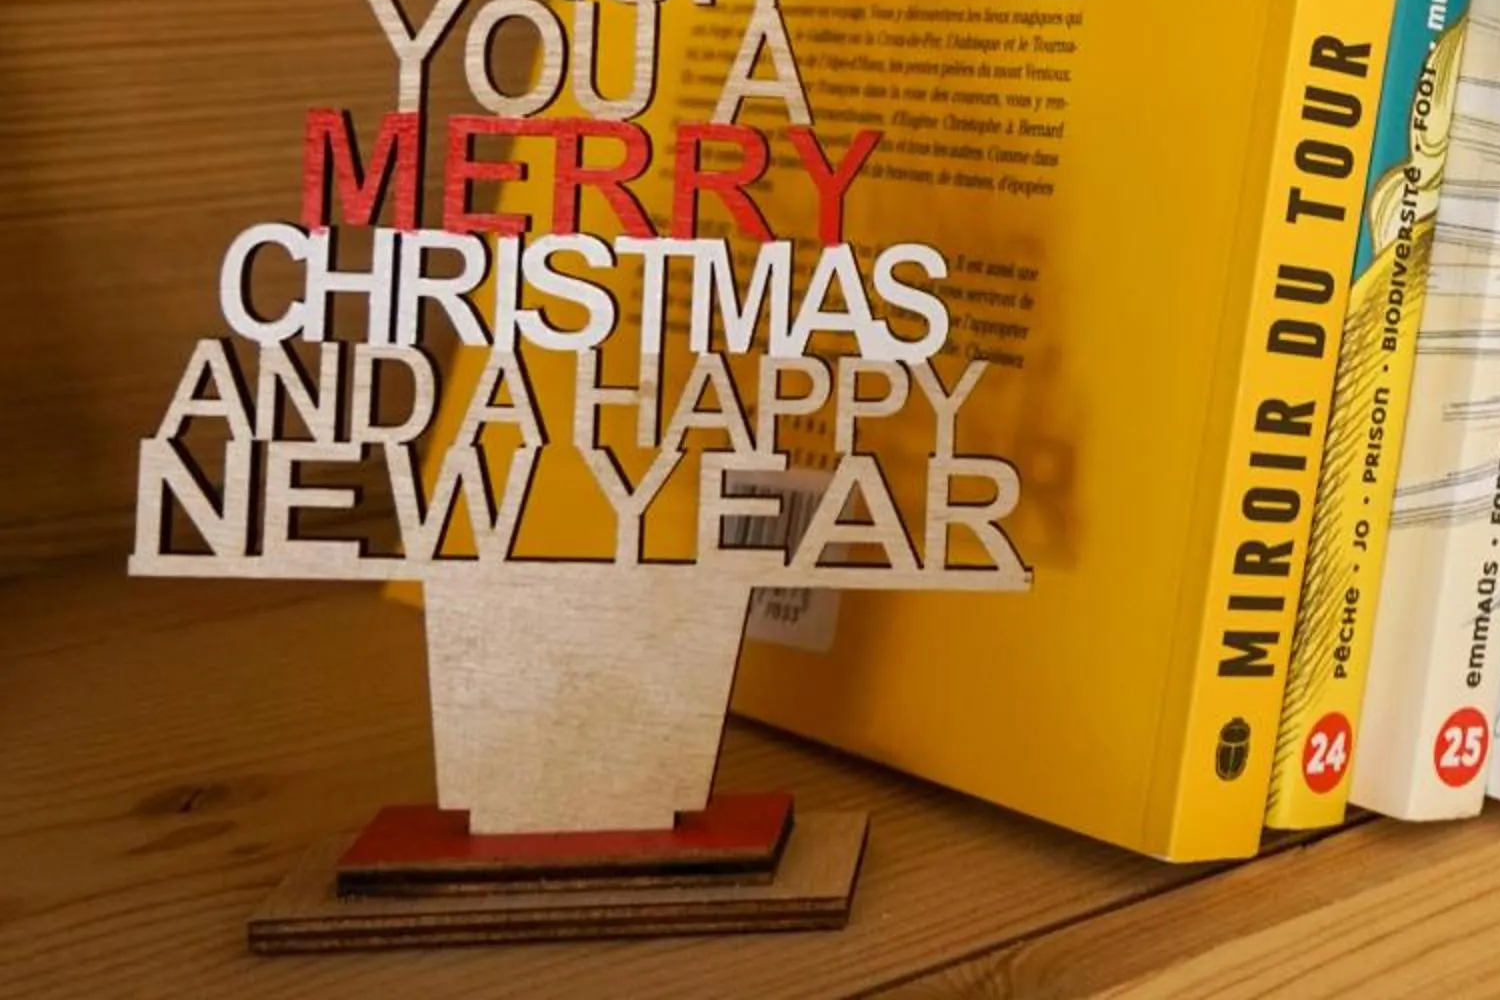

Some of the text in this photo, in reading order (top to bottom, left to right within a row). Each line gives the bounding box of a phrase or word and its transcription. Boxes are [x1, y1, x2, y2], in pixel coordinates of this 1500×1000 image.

[713, 5, 816, 127] A
[301, 107, 883, 248] MERRY
[219, 223, 952, 364] CHRISTMAS
[1217, 34, 1372, 677] MIROIR DU TOUR
[1351, 520, 1370, 552] JO
[1411, 61, 1439, 132] FOOT
[161, 337, 990, 459] AND A HAPPY
[139, 438, 1032, 572] NEW YEAR
[1306, 732, 1349, 775] 24
[1440, 727, 1485, 771] 25
